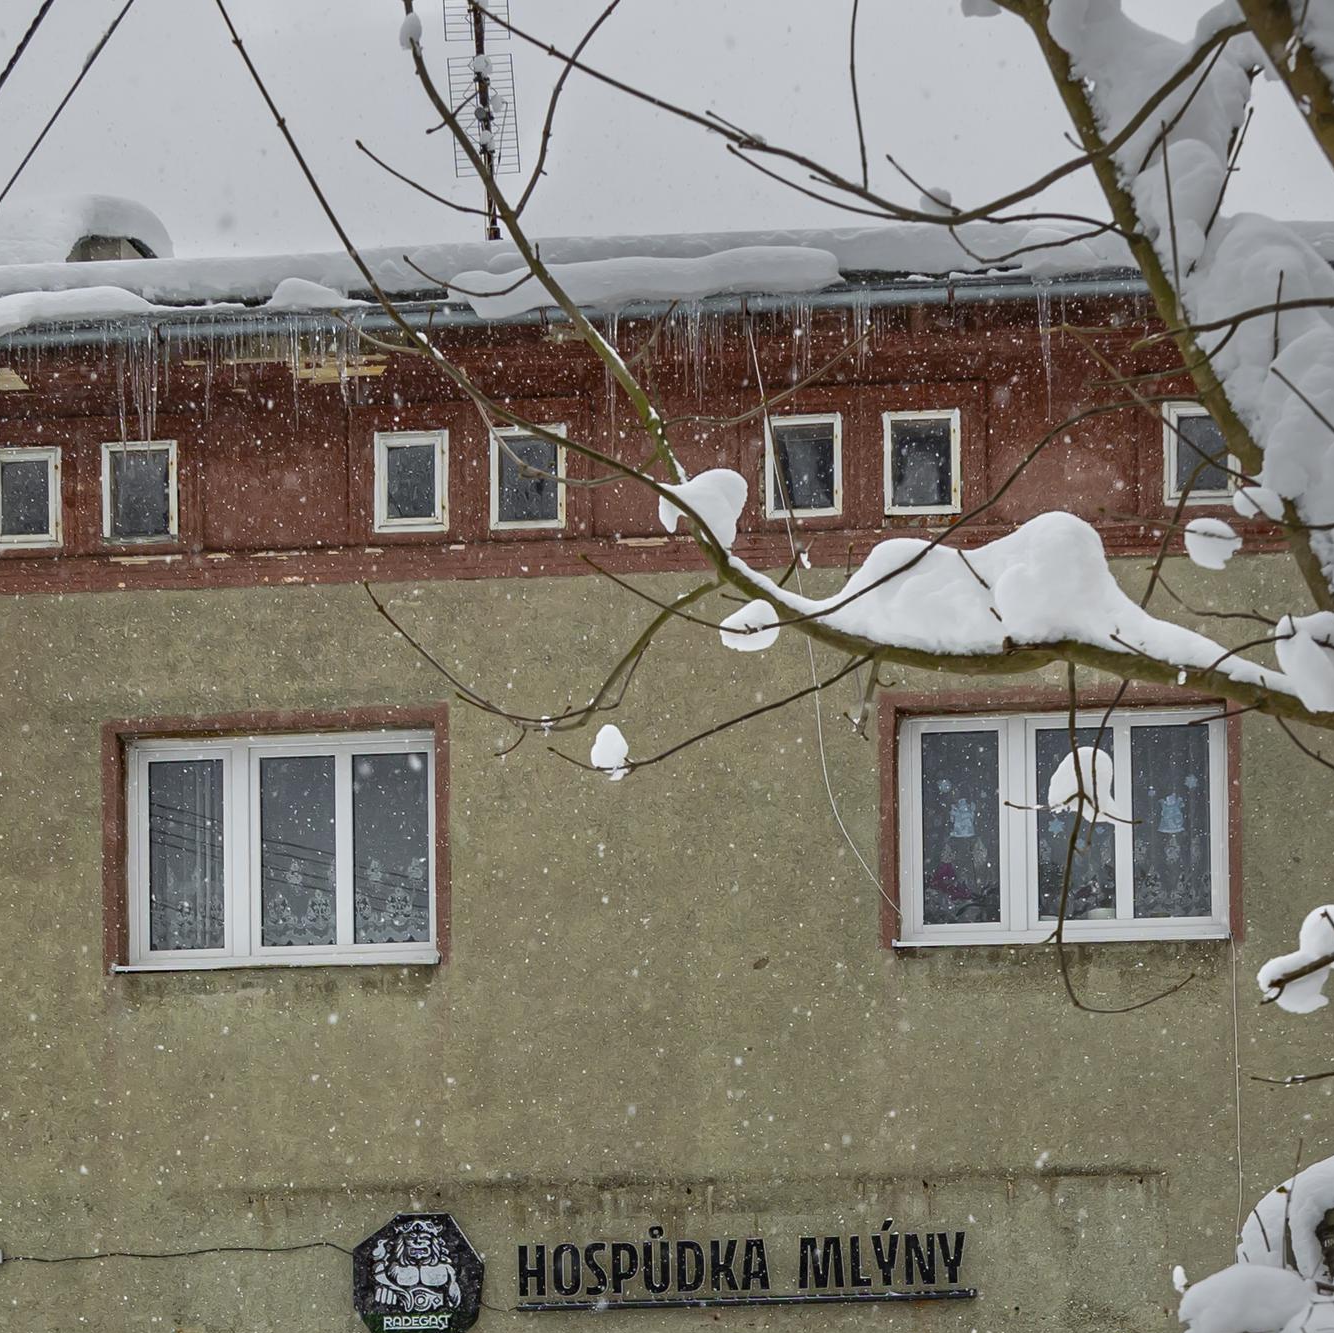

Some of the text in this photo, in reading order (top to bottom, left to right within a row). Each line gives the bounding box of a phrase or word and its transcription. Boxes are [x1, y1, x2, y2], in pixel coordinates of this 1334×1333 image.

[518, 1217, 965, 1296] HOSPŮDKA MLÝNY
[383, 1314, 452, 1331] RADEGAST
